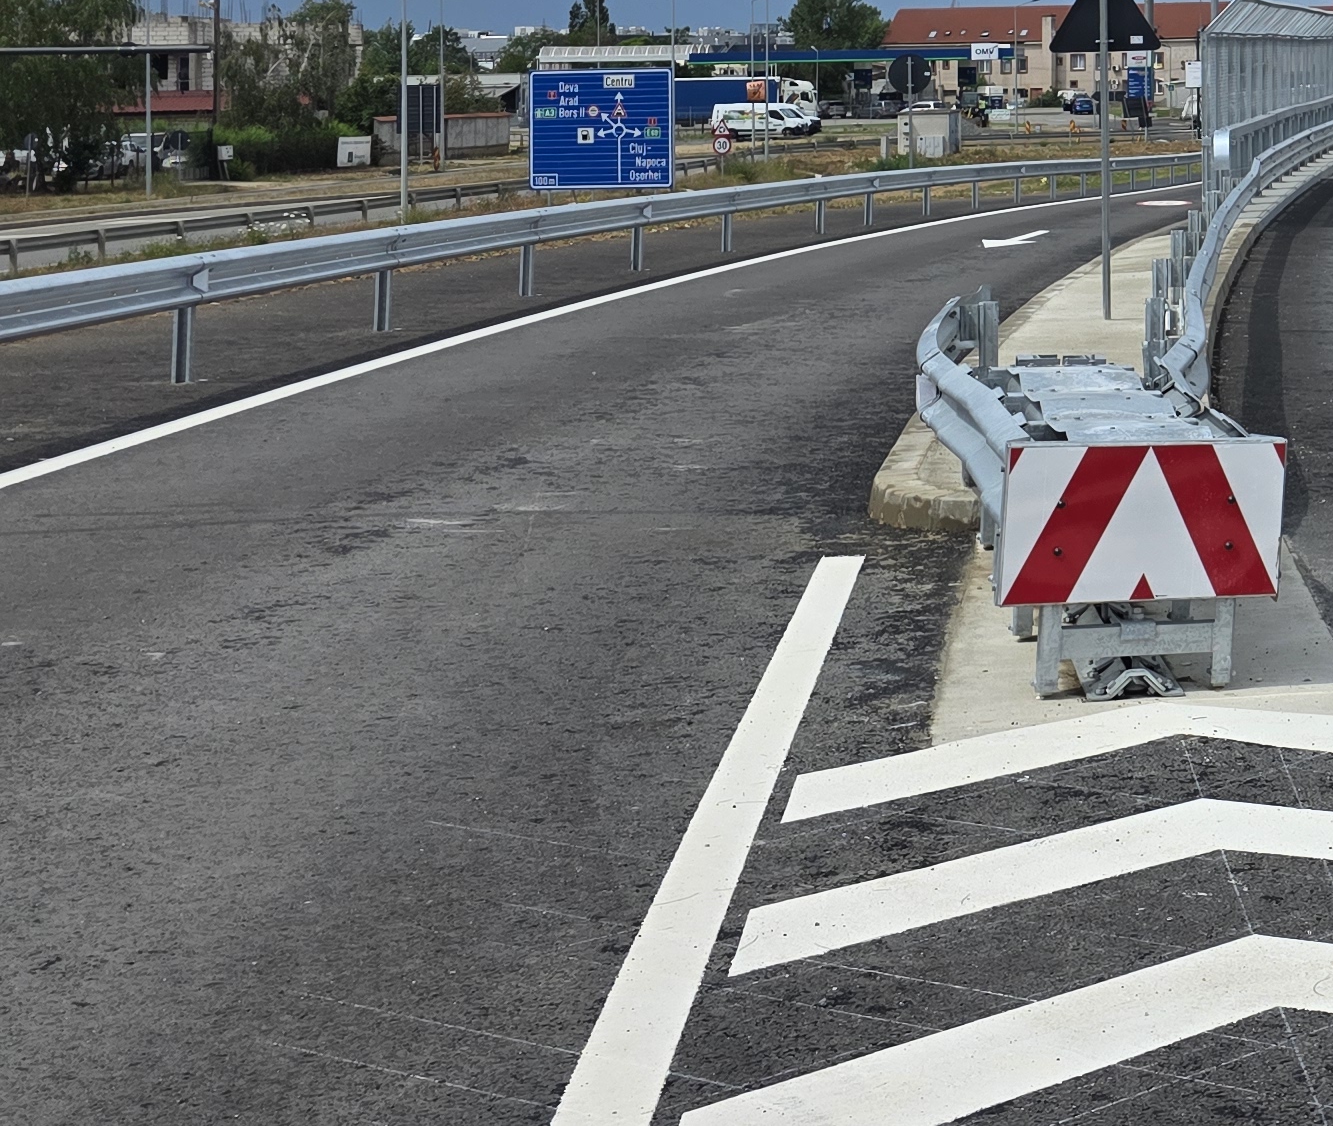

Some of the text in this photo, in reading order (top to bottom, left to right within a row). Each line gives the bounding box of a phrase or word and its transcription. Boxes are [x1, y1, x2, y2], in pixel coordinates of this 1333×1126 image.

[559, 82, 579, 93] Deva
[605, 77, 633, 87] Centru
[559, 95, 579, 106] Arad
[544, 109, 555, 117] A3
[558, 107, 578, 119] Borș
[579, 106, 585, 118] II
[629, 142, 651, 156] Cluj-
[716, 140, 728, 150] 30
[635, 156, 666, 170] Napoca
[534, 176, 547, 186] 100
